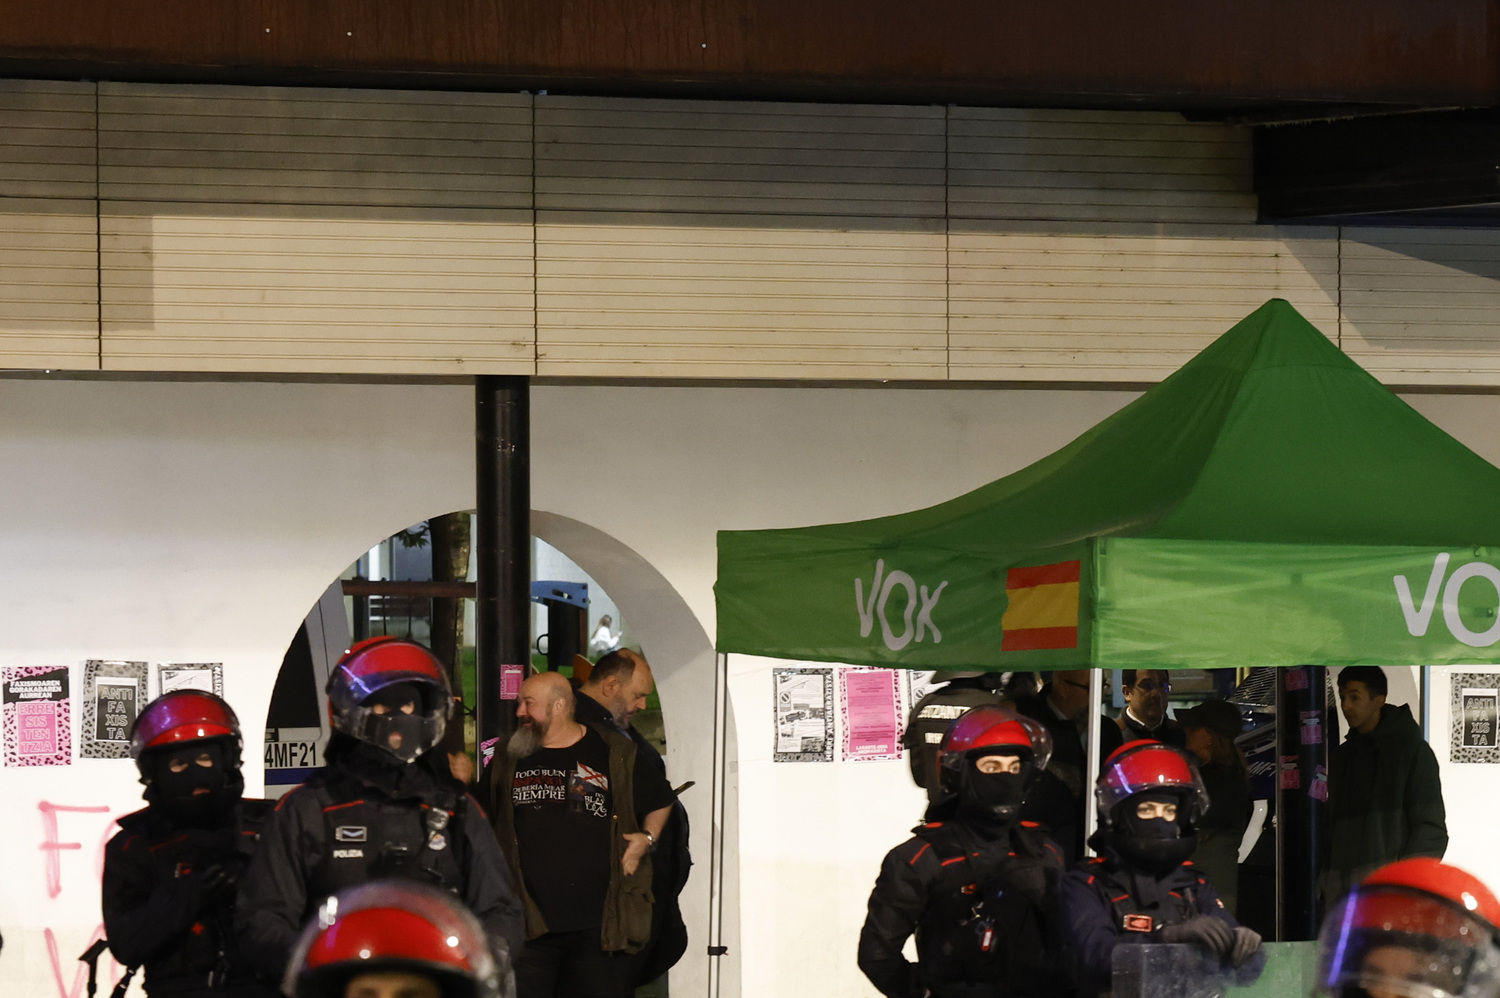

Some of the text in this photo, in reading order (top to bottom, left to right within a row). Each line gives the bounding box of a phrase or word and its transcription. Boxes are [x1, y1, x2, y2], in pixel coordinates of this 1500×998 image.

[854, 558, 949, 651] VOX
[100, 687, 133, 700] ANTI
[20, 703, 53, 714] ERRE
[107, 701, 126, 713] FA
[1465, 697, 1494, 709] ANTI
[25, 715, 47, 727] SIS
[105, 714, 128, 727] XIS
[1472, 710, 1488, 721] FA
[1471, 721, 1490, 733] XIS
[24, 728, 50, 739] TEN
[106, 727, 126, 740] TA
[1471, 734, 1488, 745] TA
[21, 740, 53, 753] TZIA
[264, 742, 317, 768] 4MF21
[515, 769, 541, 779] TODO
[513, 789, 566, 802] SIEMPRE
